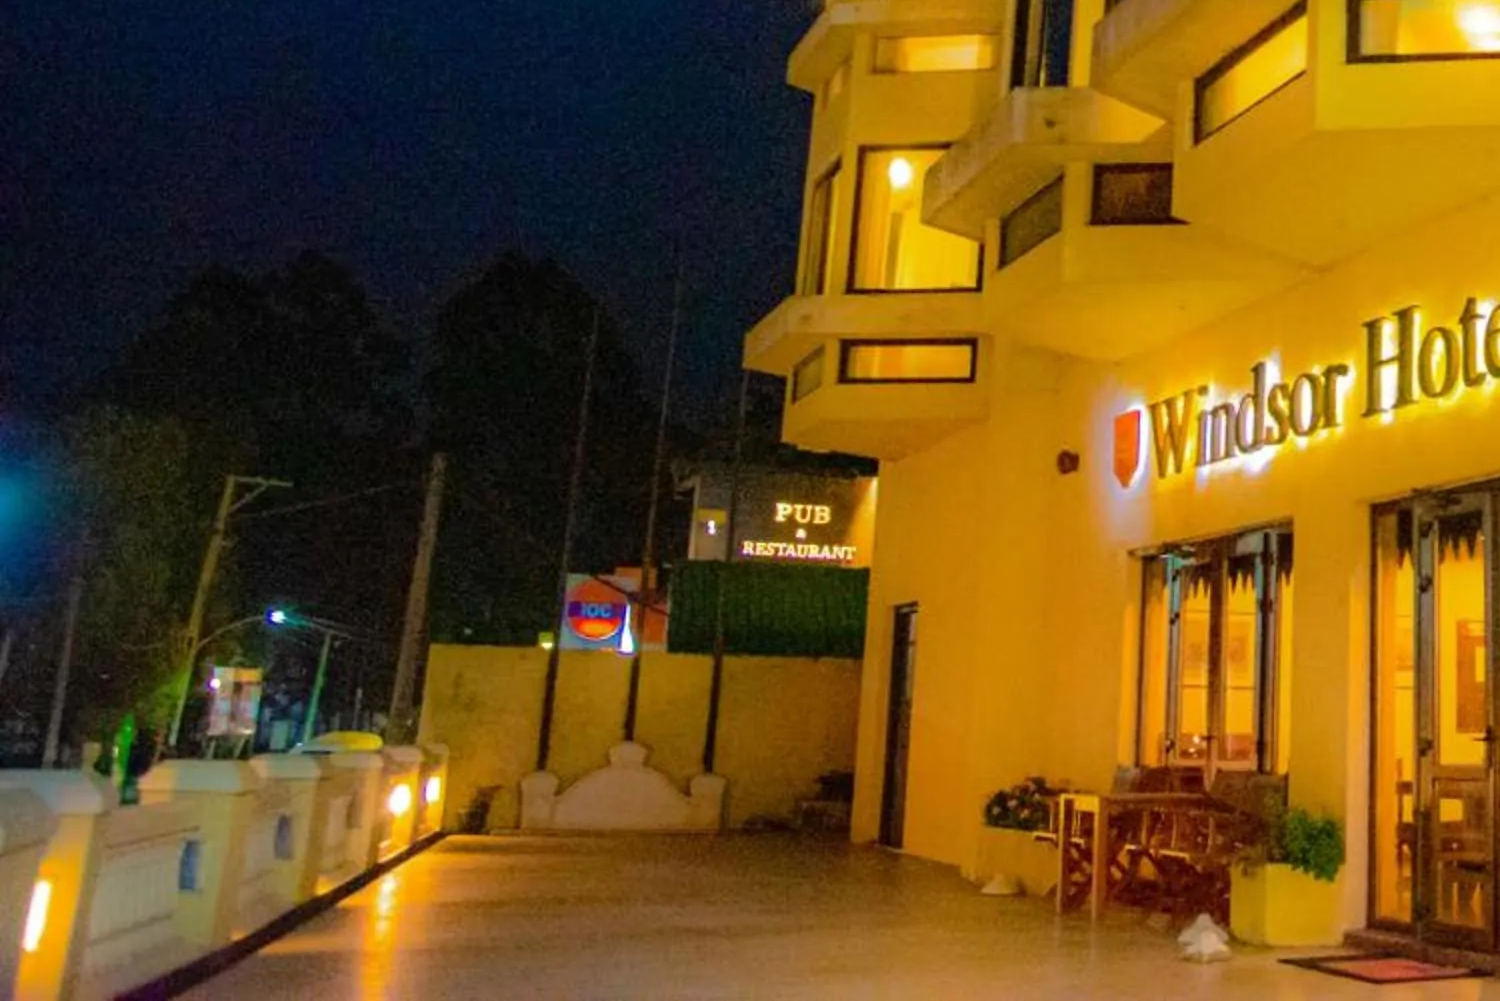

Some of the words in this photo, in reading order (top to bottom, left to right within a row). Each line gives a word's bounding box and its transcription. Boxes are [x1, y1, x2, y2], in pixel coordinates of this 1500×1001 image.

[1148, 361, 1348, 478] Windsor
[775, 502, 832, 524] PUB
[742, 540, 857, 560] RESTAURANT
